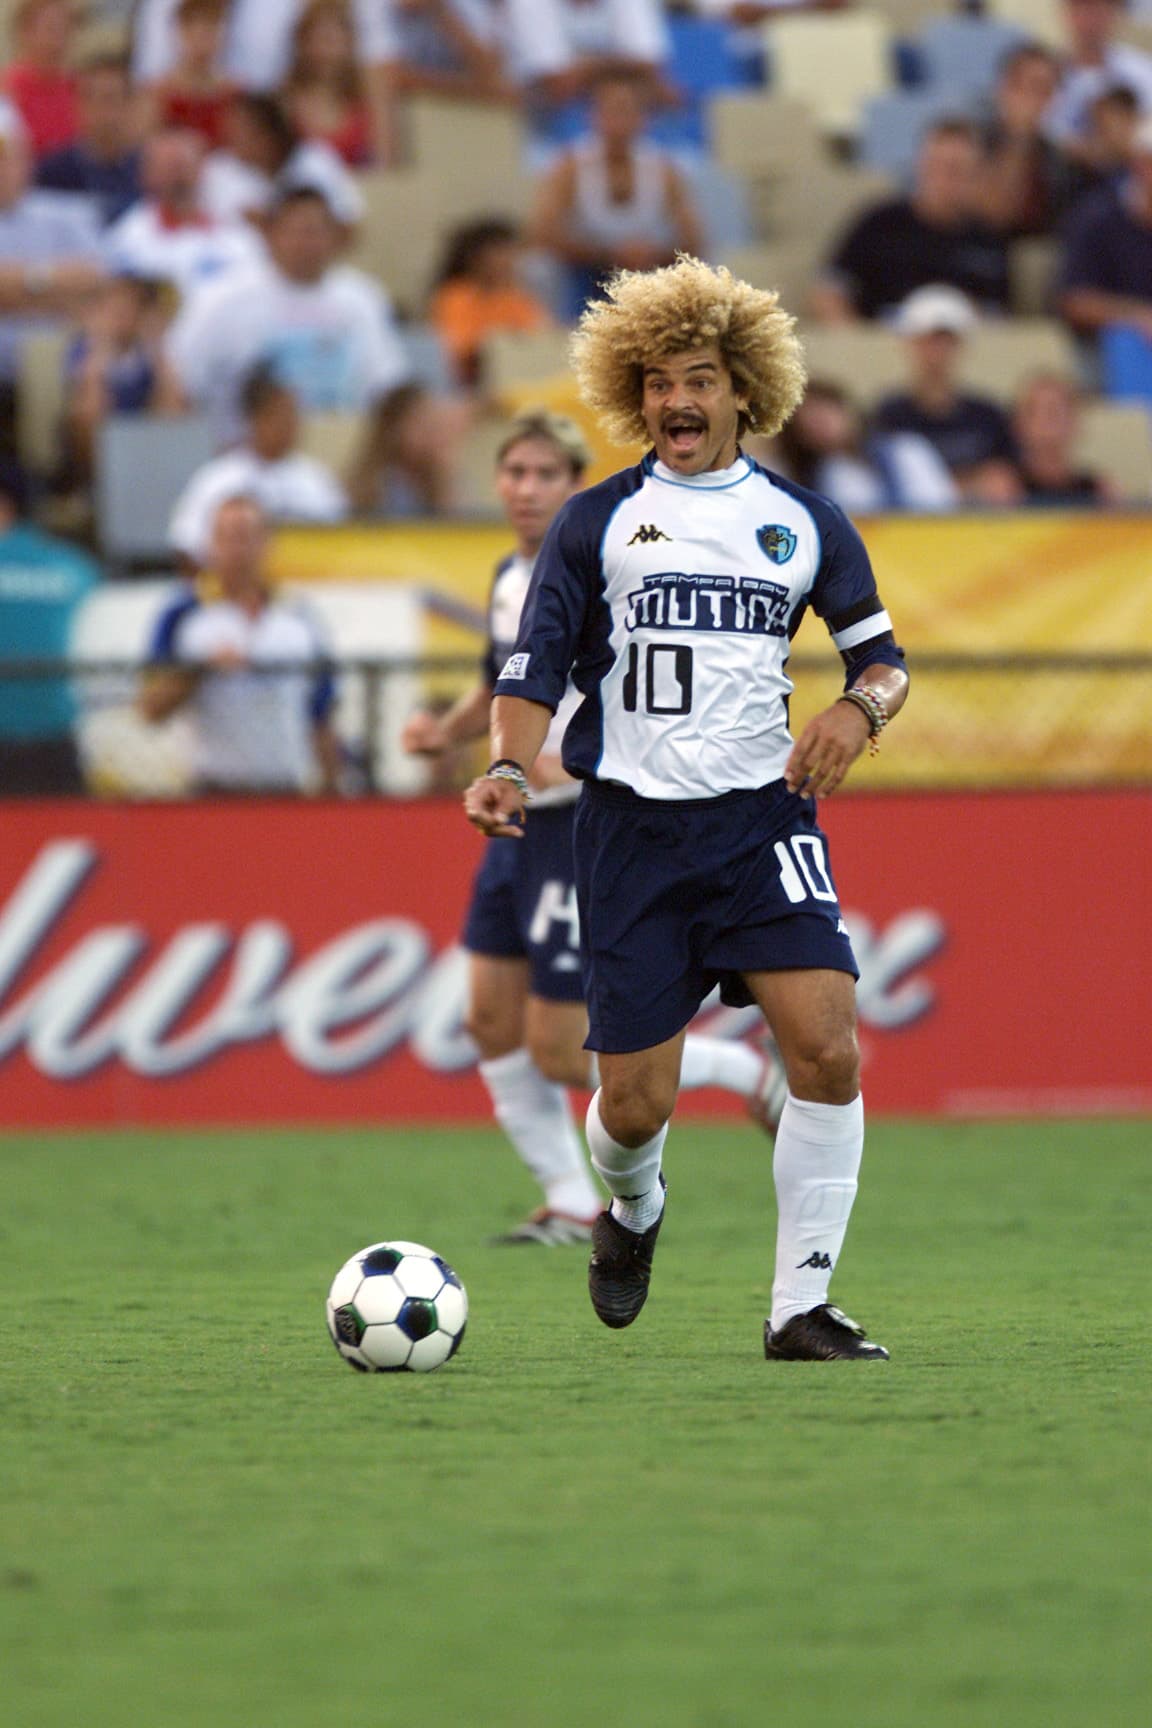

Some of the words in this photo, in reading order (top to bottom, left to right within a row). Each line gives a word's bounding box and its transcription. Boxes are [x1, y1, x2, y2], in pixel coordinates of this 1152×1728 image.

[643, 576, 732, 587] TAMPA
[742, 580, 787, 595] BAY
[623, 642, 693, 715] 10
[774, 834, 838, 903] 10
